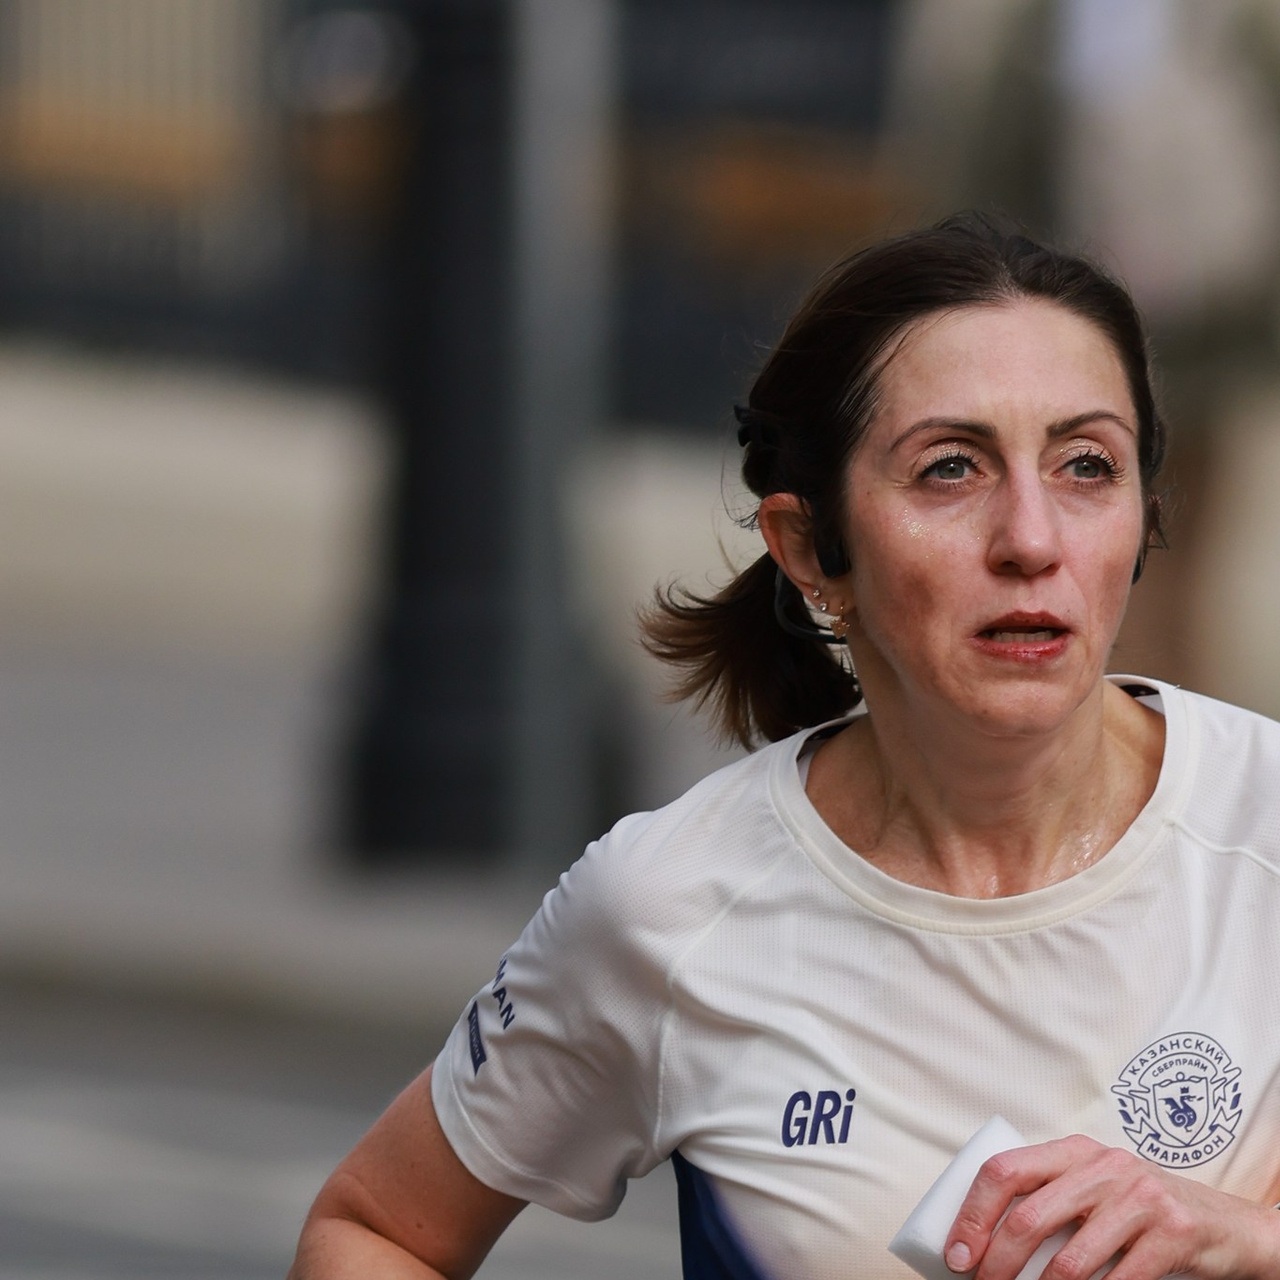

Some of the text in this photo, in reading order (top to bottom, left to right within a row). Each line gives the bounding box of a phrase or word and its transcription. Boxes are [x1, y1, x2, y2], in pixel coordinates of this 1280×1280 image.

[1128, 1038, 1224, 1076] КАЗАНСКИЙ
[1151, 1058, 1208, 1078] СБЕРПРАЙМ
[781, 1088, 856, 1148] GRi
[1146, 1135, 1225, 1164] МАРАФОН
